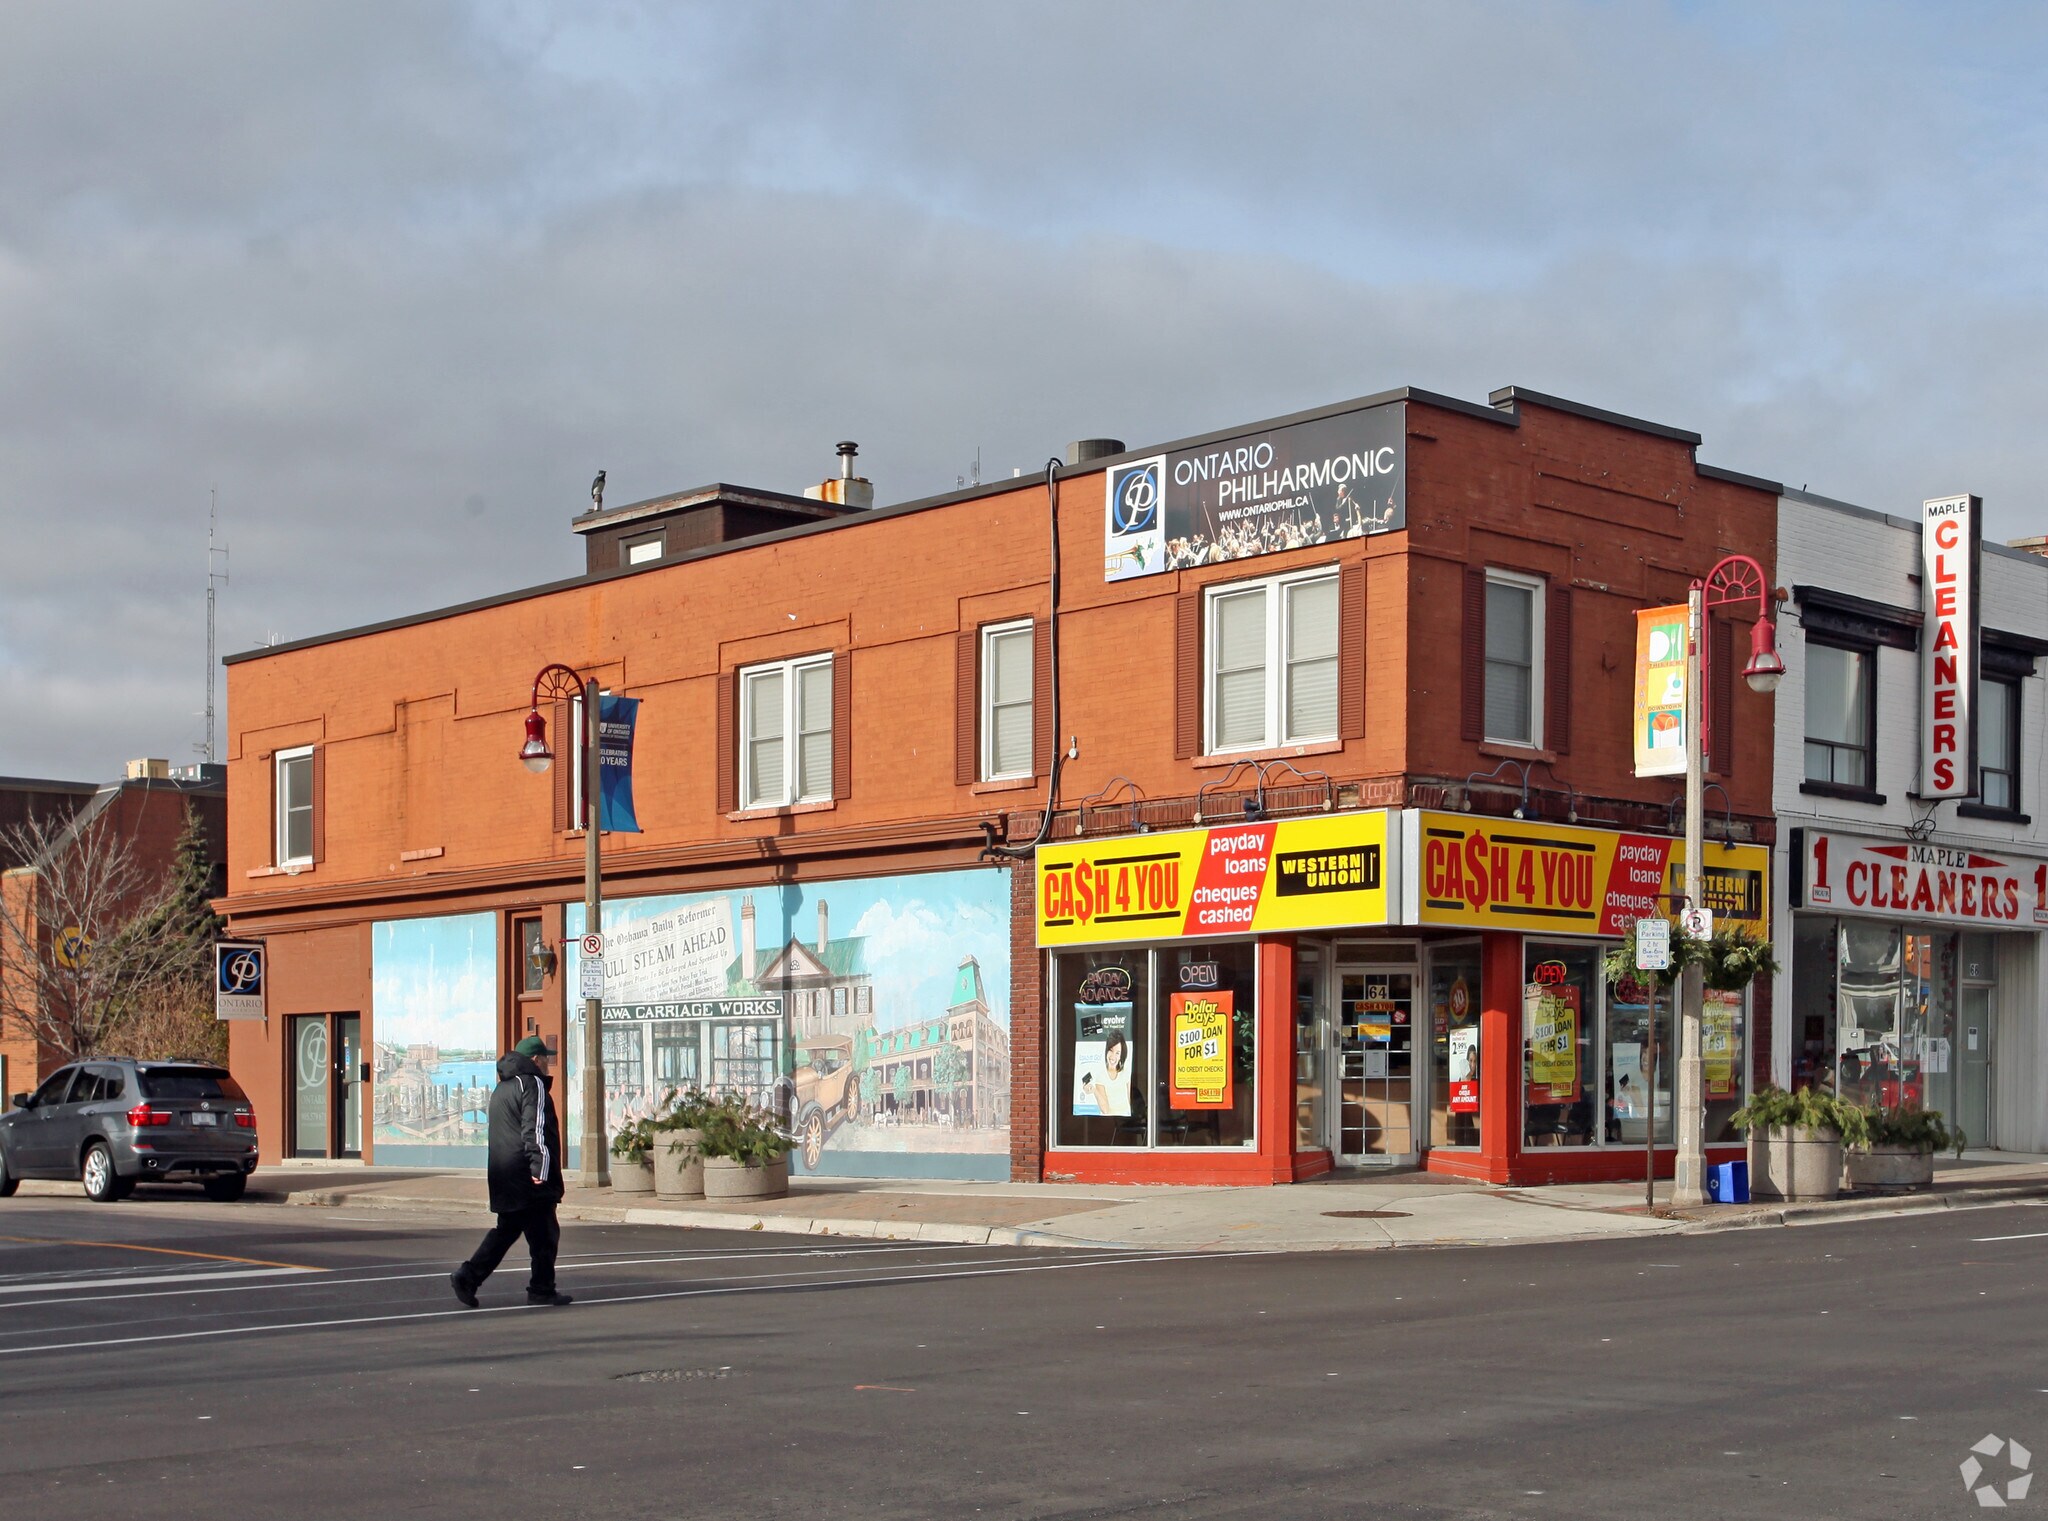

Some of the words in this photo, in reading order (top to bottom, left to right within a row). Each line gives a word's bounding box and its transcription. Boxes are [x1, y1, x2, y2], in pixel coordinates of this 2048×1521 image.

[1174, 442, 1273, 486] ONTARIO
[1218, 446, 1395, 507] PHILHARMONIC
[1218, 495, 1309, 522] WWW.ONTARIOPHIL.CA
[1928, 501, 1966, 518] MAPLE
[1932, 519, 1960, 791] CLEANERS
[1647, 703, 1683, 712] DOWNTOWN
[606, 757, 627, 766] YEARS
[1210, 833, 1265, 856] payday
[1619, 843, 1661, 865] payday
[1225, 855, 1267, 875] loans
[1281, 853, 1361, 875] WESTERN
[1813, 836, 1828, 886] 1
[1911, 846, 1966, 869] MAPLE
[1306, 868, 1361, 888] UNION
[1426, 829, 1509, 913] CA$H
[1516, 849, 1535, 904] 4
[1540, 851, 1593, 909] YOU
[1629, 866, 1661, 885] loans
[1044, 858, 1109, 926] CA$H
[1115, 873, 1131, 912] 4
[1135, 861, 1179, 911] YOU
[1675, 872, 1745, 893] WTERN
[1846, 860, 2019, 920] CLEANERS
[2034, 864, 2047, 909] 1
[1193, 884, 1258, 910] cheques
[1606, 891, 1654, 910] cheques
[1815, 889, 1828, 897] HOUR
[1198, 904, 1253, 925] cashed
[616, 927, 649, 946] Oshawa
[651, 919, 674, 935] Daily
[677, 905, 717, 927] Reformer
[604, 961, 627, 979] ULL
[634, 943, 675, 971] STEAM
[682, 926, 726, 956] AHEAD
[687, 958, 698, 968] And
[699, 953, 719, 965] Speeded
[720, 949, 728, 959] Up
[1087, 972, 1121, 985] PAYDAY
[1179, 965, 1218, 983] OPEN
[1535, 964, 1565, 984] OPEN
[1969, 964, 1979, 976] 66
[1080, 986, 1129, 1001] ADVANCE
[1369, 986, 1387, 999] 64
[1540, 994, 1567, 1009] Dollar
[219, 999, 263, 1008] ONTARIO
[635, 1004, 713, 1019] CARRIAGE
[719, 1001, 780, 1015] WORKS.
[1185, 999, 1218, 1015] Dollar
[1702, 999, 1724, 1010] ollar
[1103, 1014, 1126, 1024] evolve
[1187, 1011, 1216, 1026] Days
[1542, 1006, 1565, 1021] Days
[1179, 1030, 1201, 1045] $100
[1202, 1025, 1223, 1040] LOAN
[1535, 1024, 1554, 1039] $100
[1555, 1020, 1572, 1034] LOAN
[1184, 1045, 1202, 1060] FOR
[1204, 1042, 1216, 1056] $1
[1540, 1041, 1556, 1053] FOR
[1557, 1036, 1567, 1050] $1
[1715, 1036, 1725, 1049] $1
